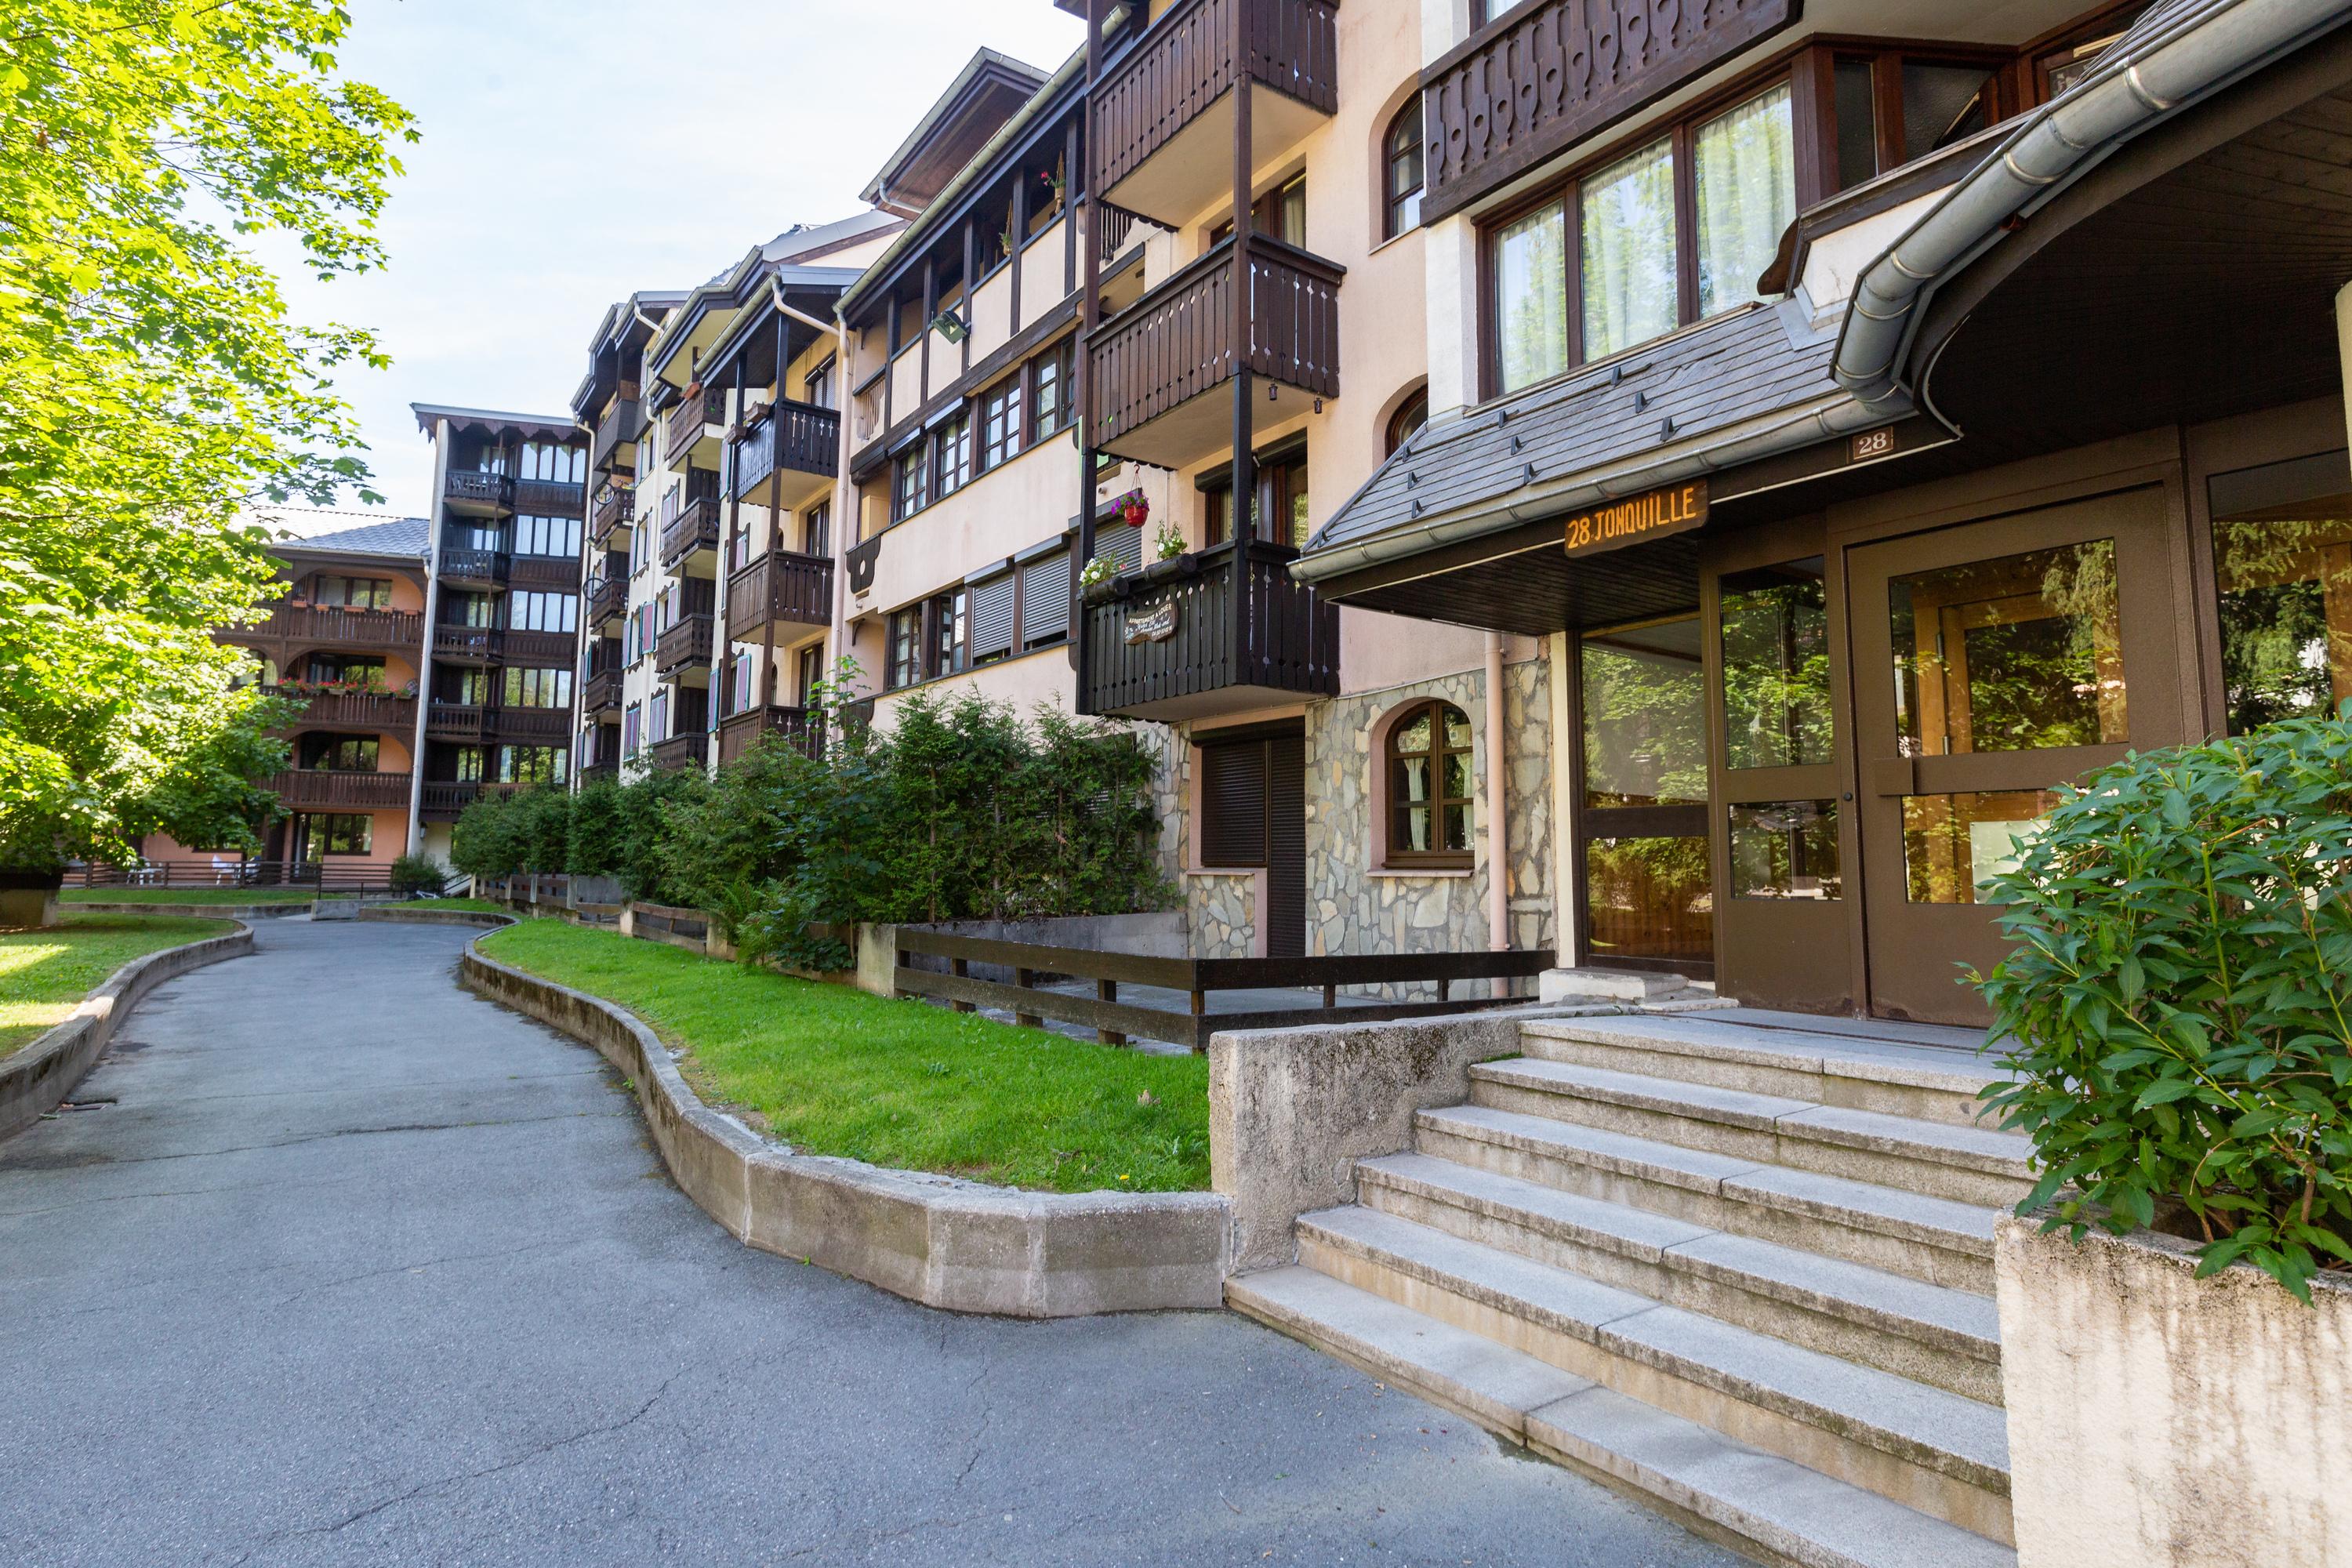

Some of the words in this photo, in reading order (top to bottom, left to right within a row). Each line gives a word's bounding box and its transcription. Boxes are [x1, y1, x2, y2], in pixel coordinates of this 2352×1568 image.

[1859, 432, 1887, 455] 28
[1568, 517, 1590, 549] 28
[1595, 487, 1697, 541] JONQUILLE
[1159, 603, 1172, 615] LOUER
